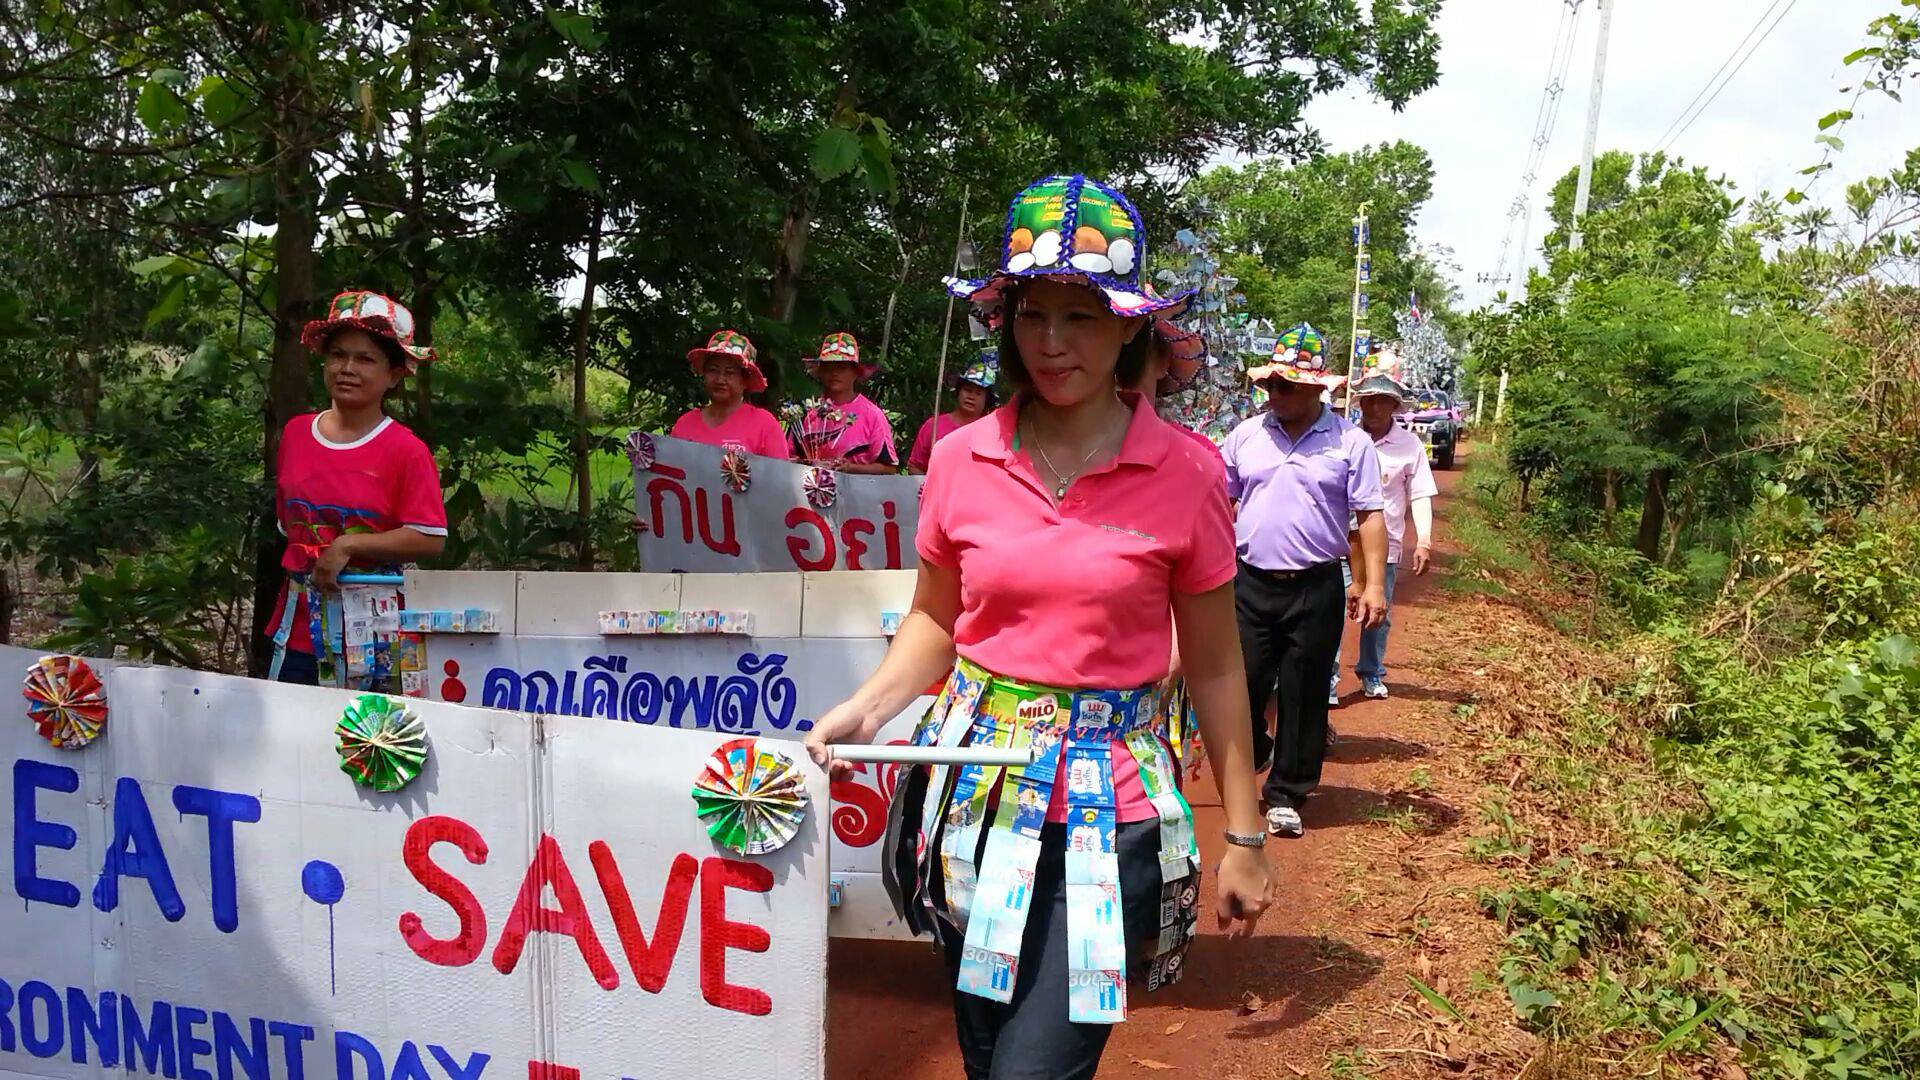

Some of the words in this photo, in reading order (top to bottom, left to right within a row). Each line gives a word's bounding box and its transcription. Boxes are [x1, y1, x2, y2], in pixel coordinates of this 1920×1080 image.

[645, 463, 742, 558] กิน
[785, 500, 902, 572] อย่
[1018, 704, 1055, 719] MILO
[12, 757, 262, 933] EAT
[398, 814, 774, 1016] SAVE
